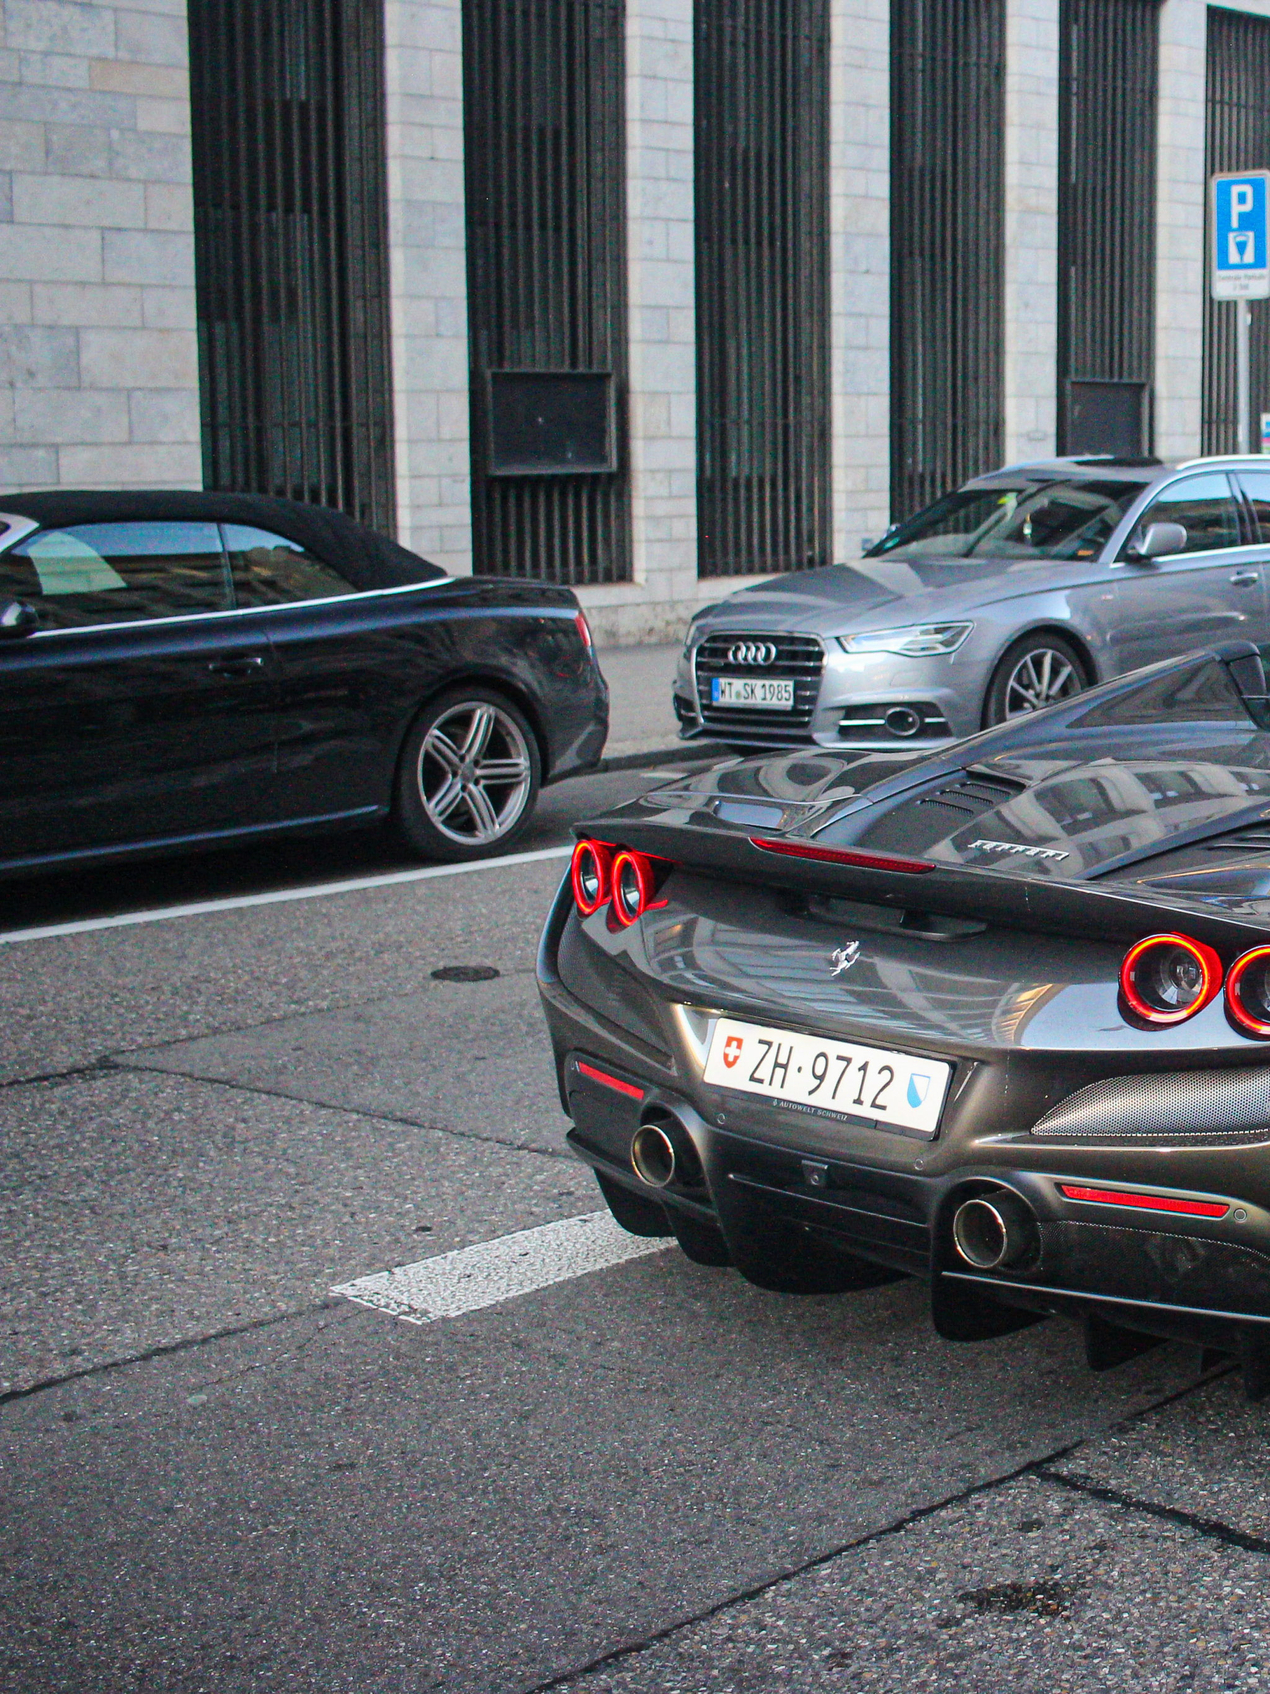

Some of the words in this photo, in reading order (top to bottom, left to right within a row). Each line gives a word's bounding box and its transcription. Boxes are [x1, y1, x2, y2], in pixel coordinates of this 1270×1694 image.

[1231, 184, 1253, 228] P
[743, 683, 757, 701] SK
[761, 683, 791, 702] 1985
[779, 1101, 815, 1114] AUTOWELT
[817, 1109, 848, 1121] SCHWEIZ
